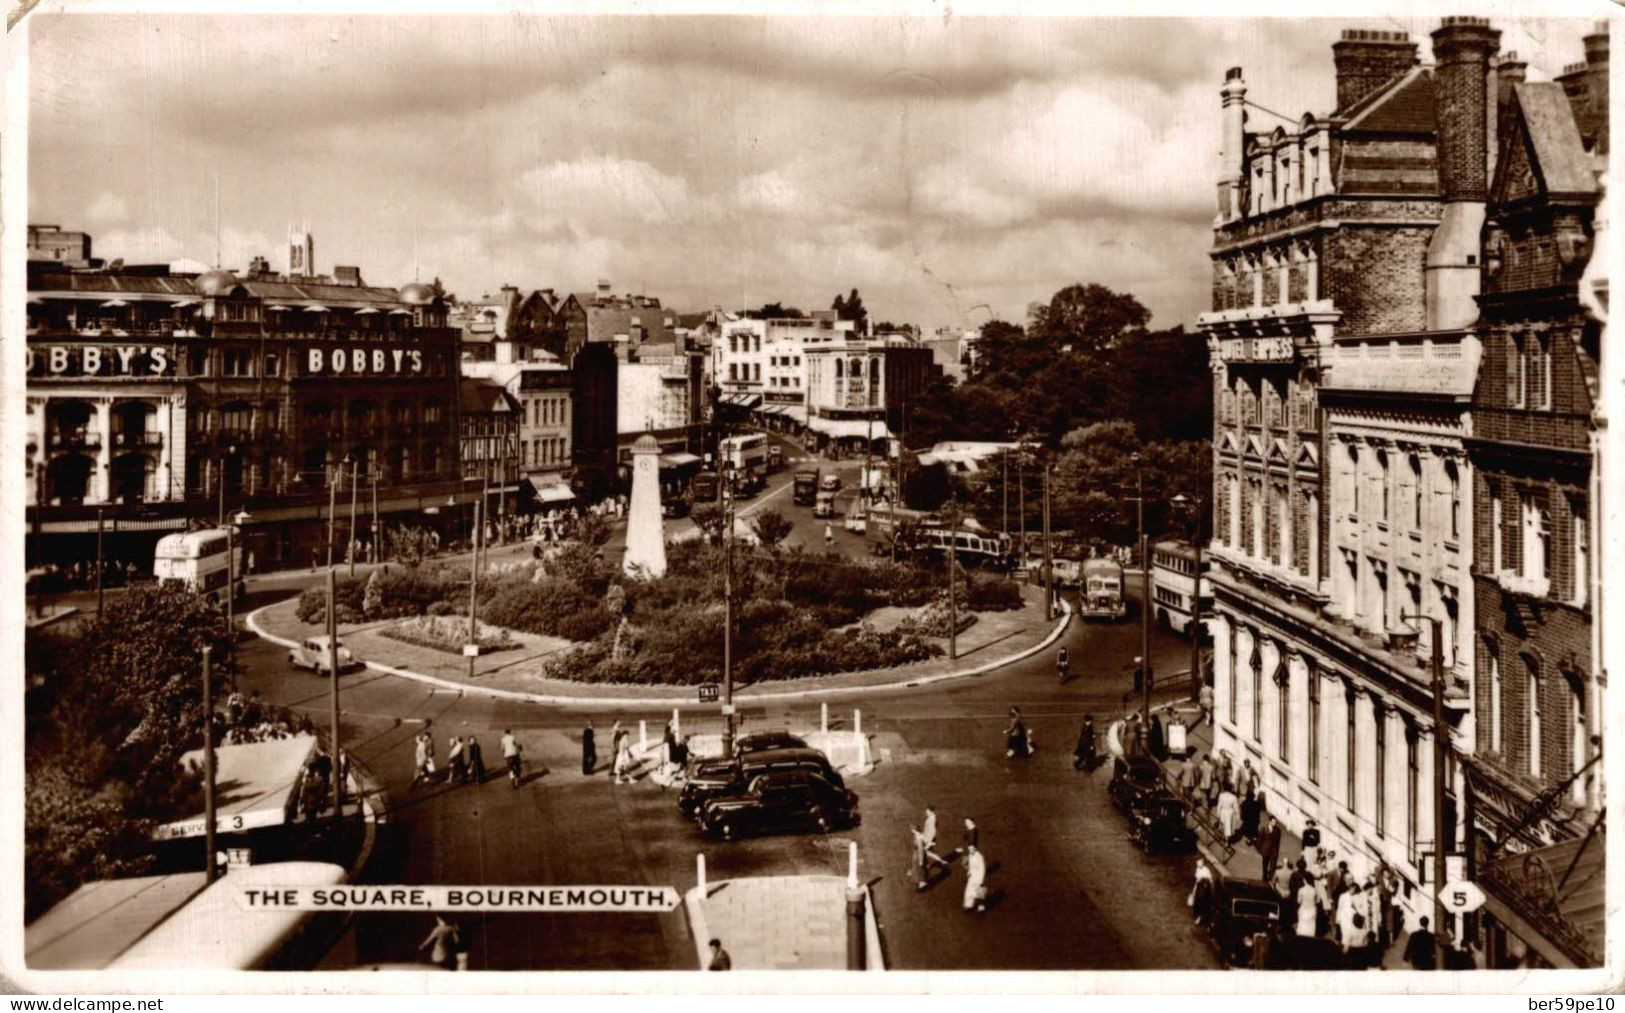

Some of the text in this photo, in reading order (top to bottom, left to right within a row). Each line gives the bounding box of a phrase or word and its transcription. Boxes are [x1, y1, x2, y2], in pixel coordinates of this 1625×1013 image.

[309, 348, 422, 373] BOBBY'S
[232, 815, 245, 829] 3
[1453, 891, 1467, 907] 5
